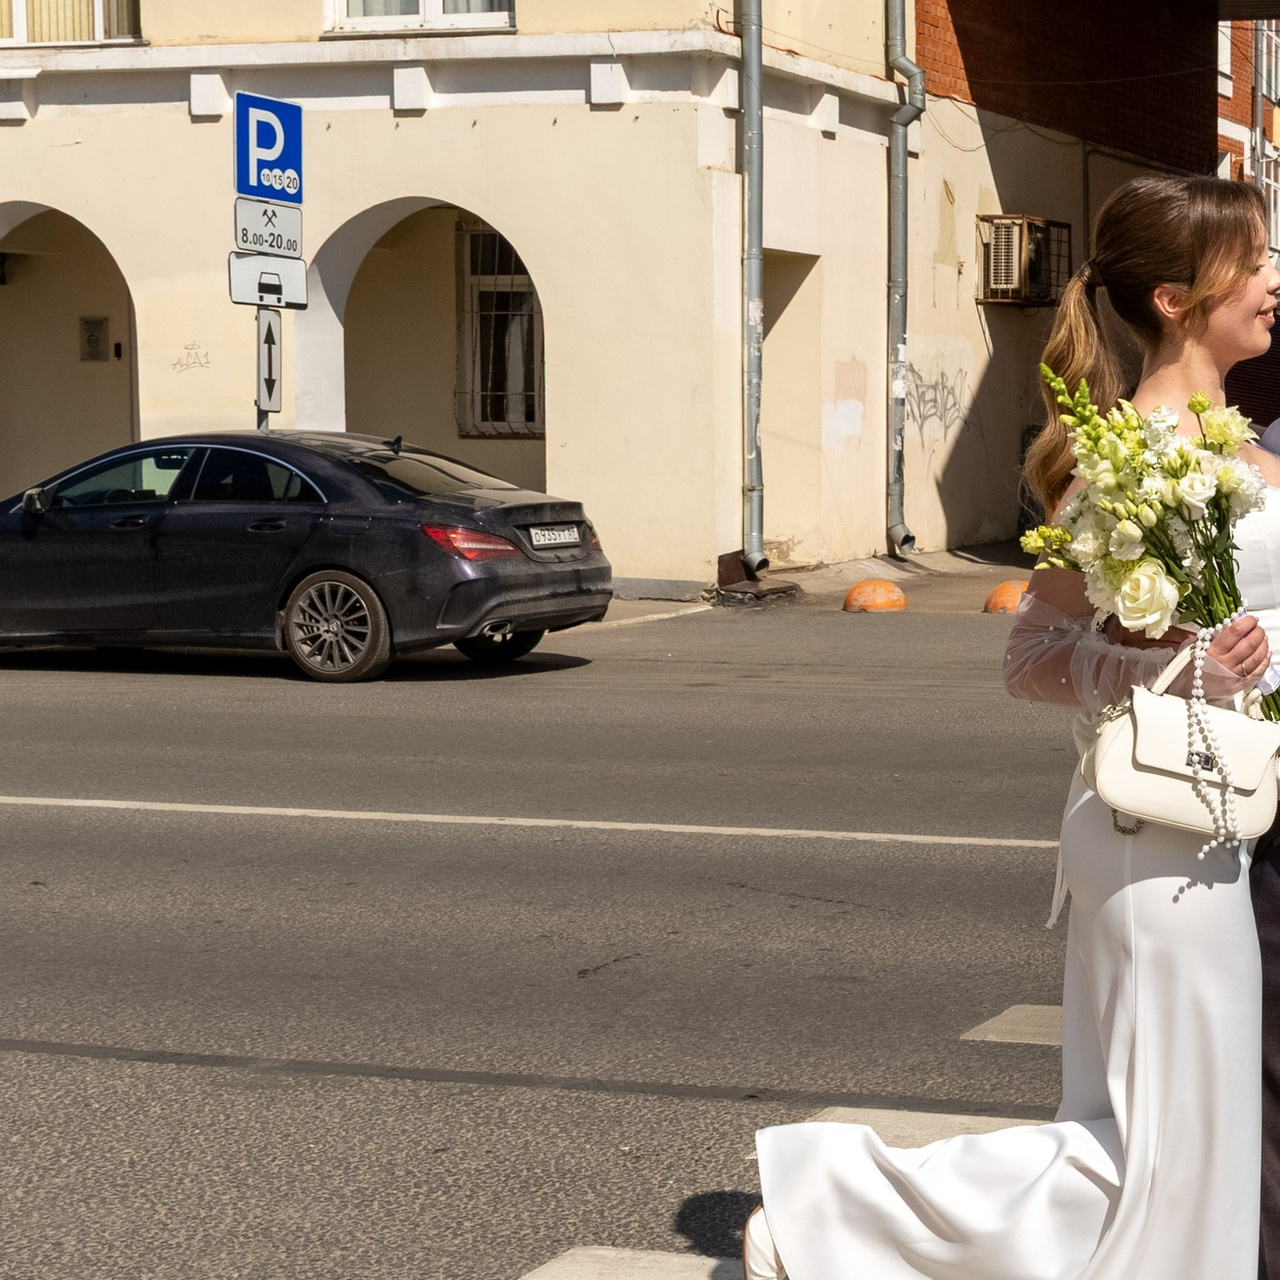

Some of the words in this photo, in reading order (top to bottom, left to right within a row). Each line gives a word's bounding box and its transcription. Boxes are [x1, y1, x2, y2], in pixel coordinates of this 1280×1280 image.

[248, 107, 285, 186] P
[262, 173, 271, 183] 10
[273, 175, 283, 187] 15
[286, 176, 298, 189] 20
[241, 228, 297, 252] 8.00-20.00
